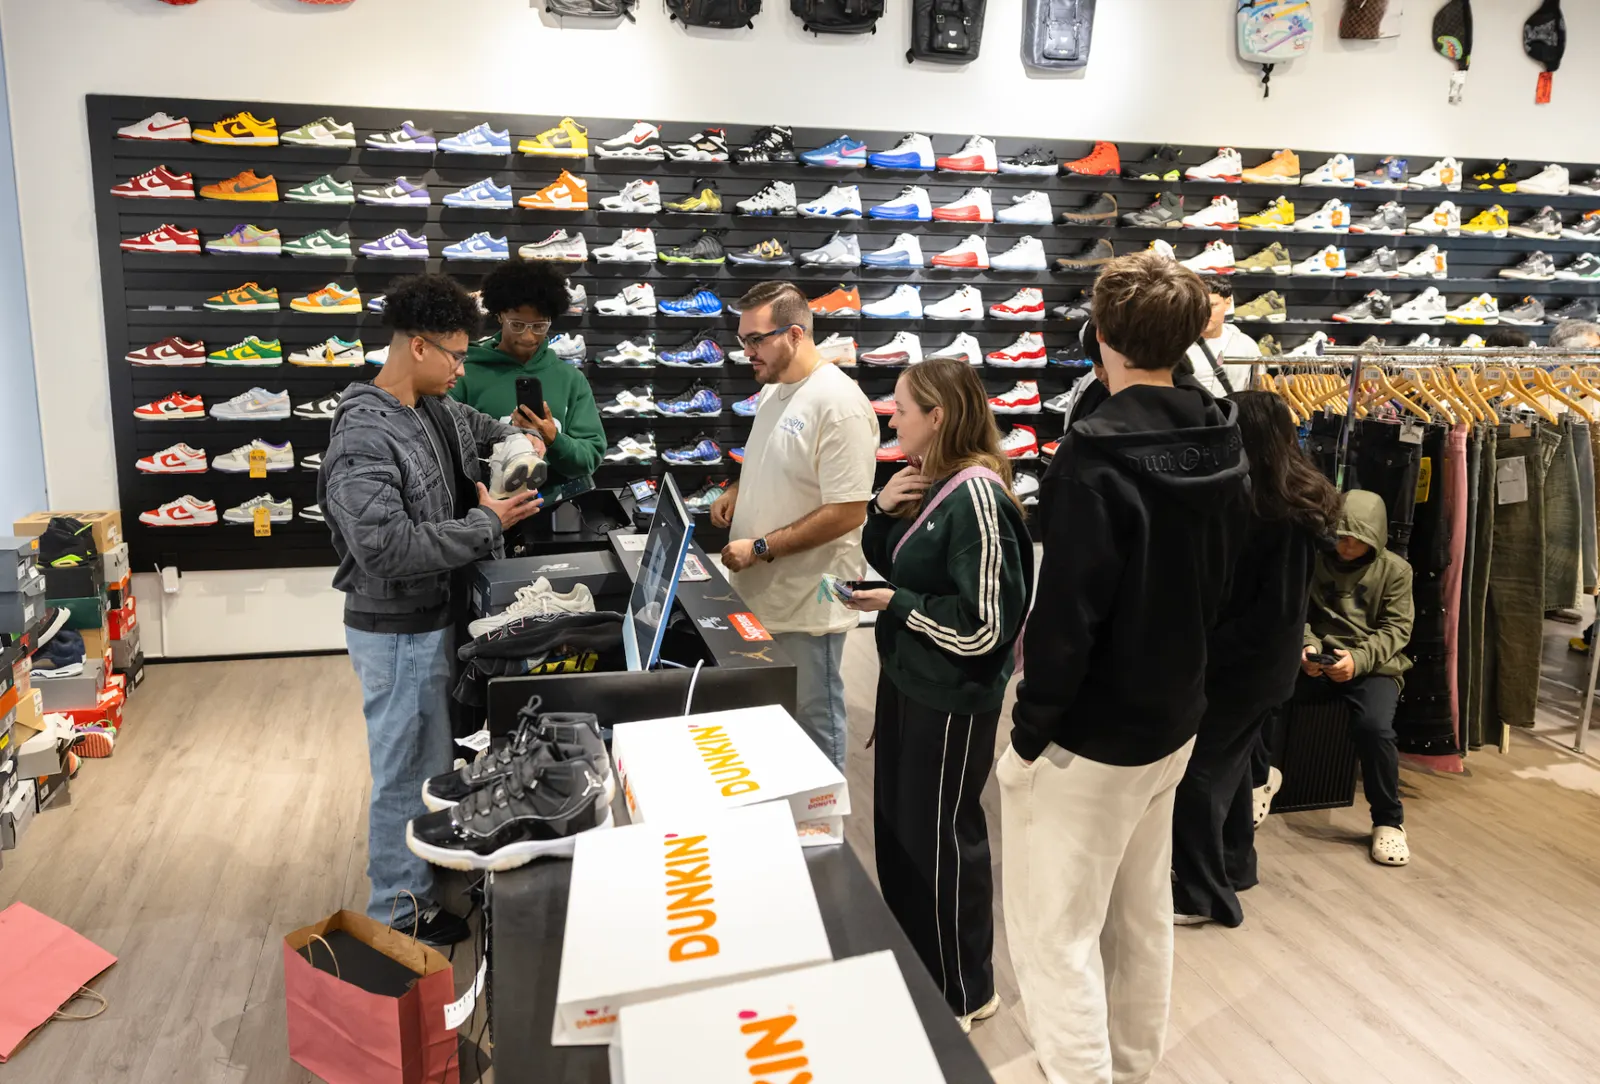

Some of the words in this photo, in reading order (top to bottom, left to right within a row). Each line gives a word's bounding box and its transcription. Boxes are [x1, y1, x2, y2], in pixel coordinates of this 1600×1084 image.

[688, 725, 761, 797] DUNKIN'
[807, 798, 837, 811] DONUTS
[809, 792, 834, 805] DOZEN
[664, 833, 720, 962] DUNKIN'
